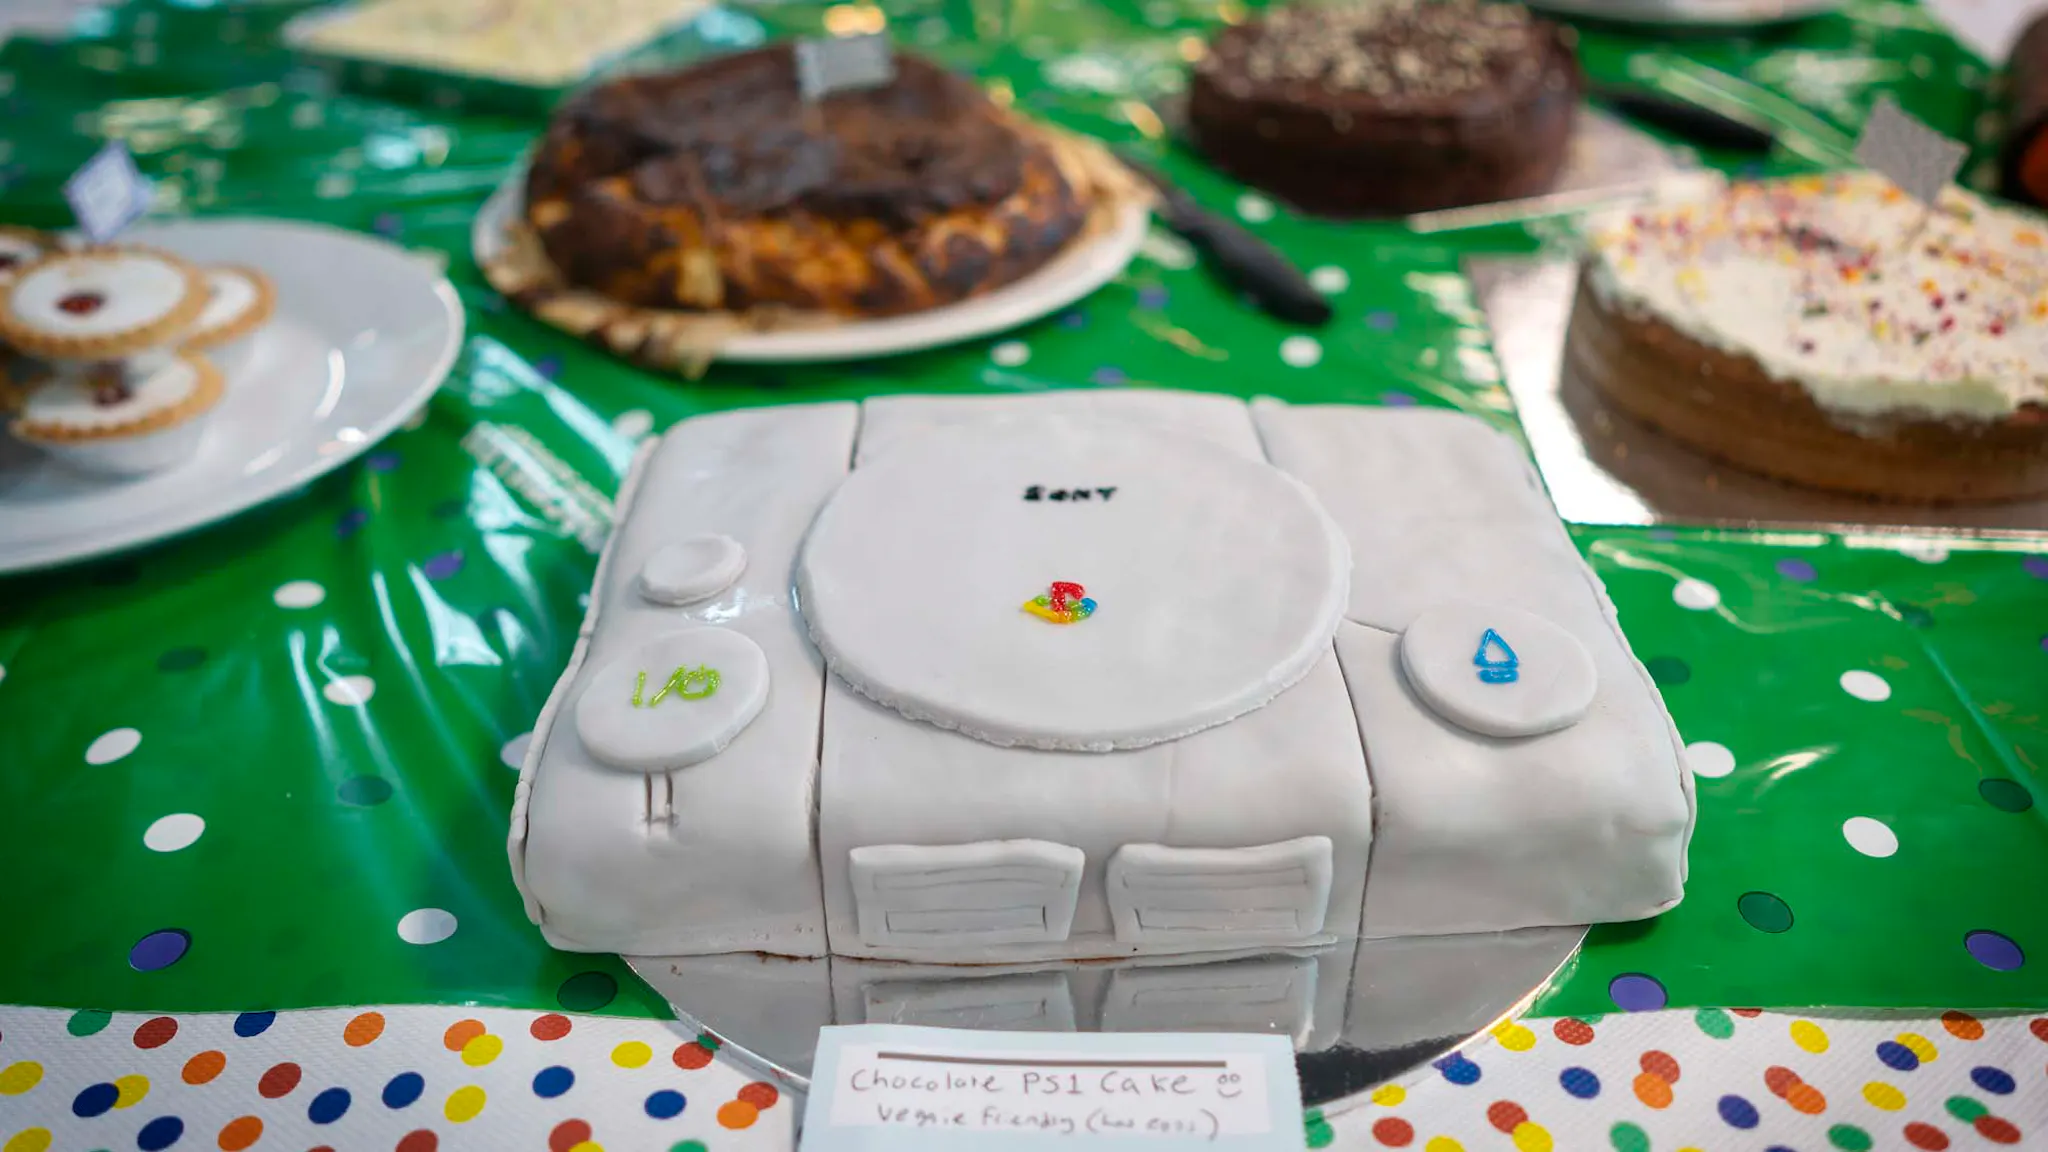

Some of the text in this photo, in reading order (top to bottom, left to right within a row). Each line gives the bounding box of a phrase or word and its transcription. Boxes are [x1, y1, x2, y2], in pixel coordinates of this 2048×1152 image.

[851, 1069, 1197, 1094] Chocolate PS1 Cake
